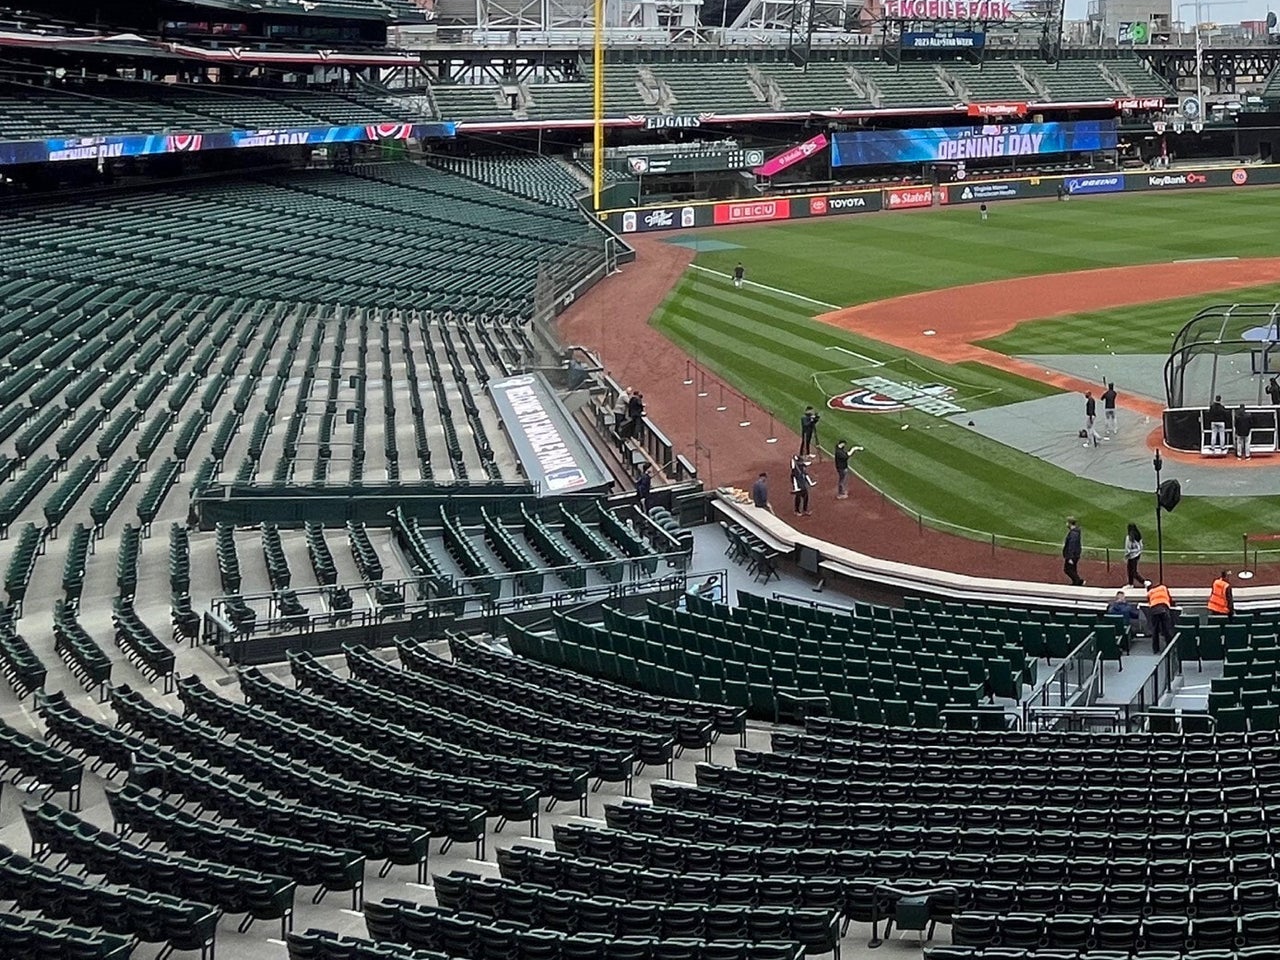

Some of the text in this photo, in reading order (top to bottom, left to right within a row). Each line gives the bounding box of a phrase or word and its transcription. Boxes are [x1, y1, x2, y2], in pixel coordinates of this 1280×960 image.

[938, 132, 1043, 160] OPENING DAY
[1081, 178, 1118, 187] BOEING
[1149, 175, 1186, 186] KeyBank
[829, 197, 865, 209] TOYOTA
[733, 204, 773, 217] BECU
